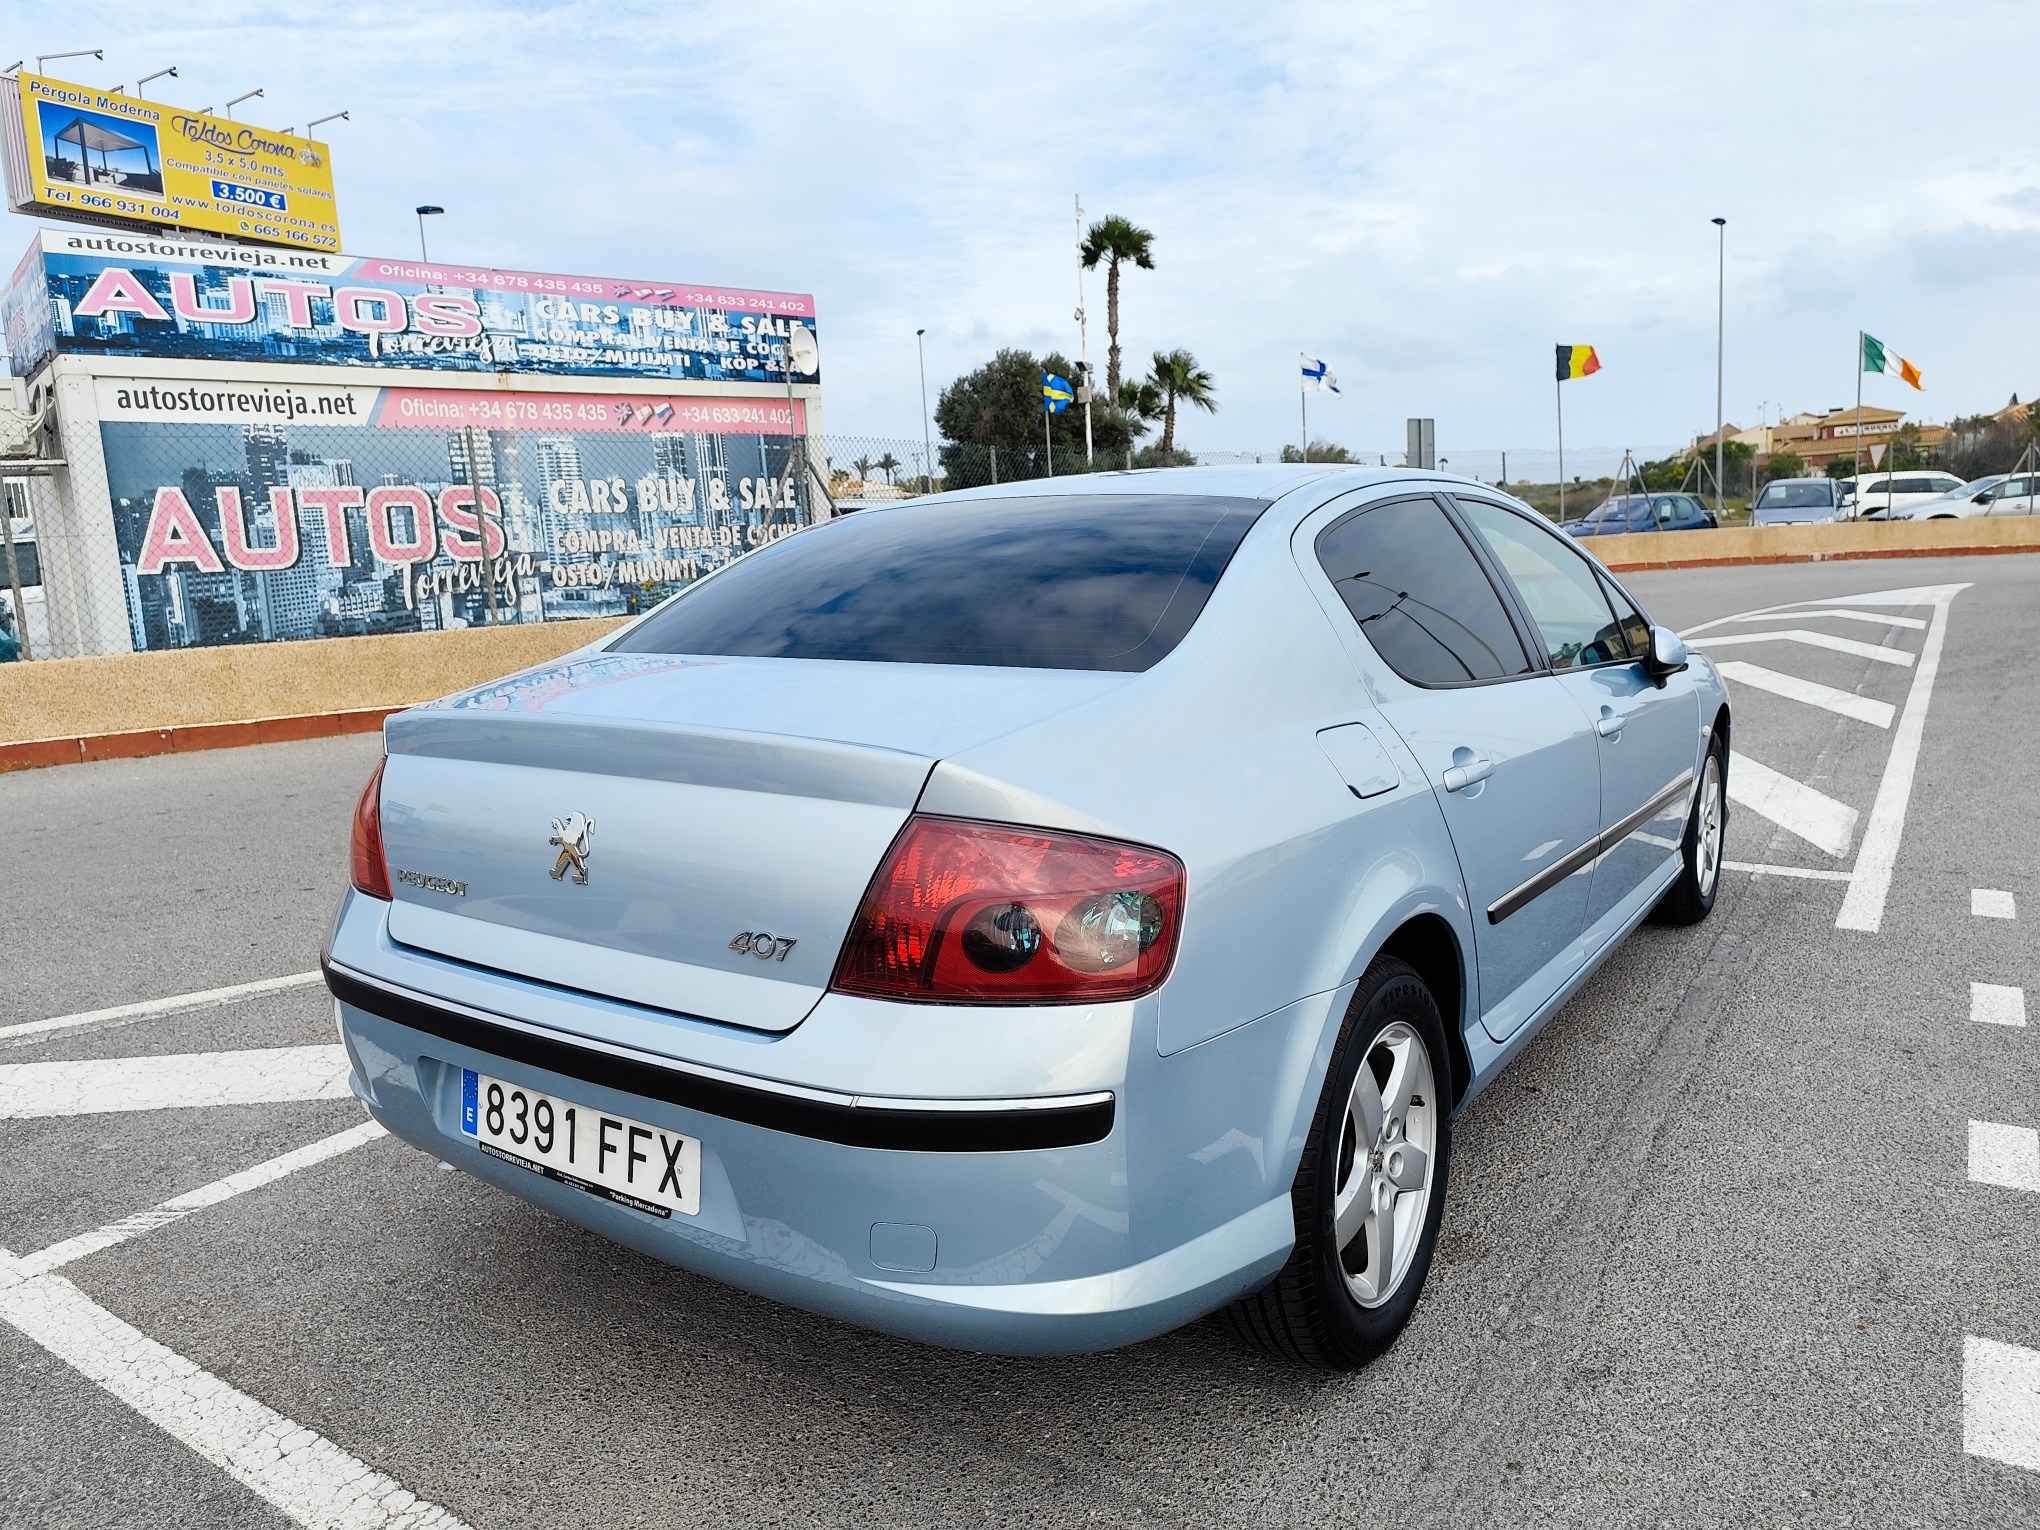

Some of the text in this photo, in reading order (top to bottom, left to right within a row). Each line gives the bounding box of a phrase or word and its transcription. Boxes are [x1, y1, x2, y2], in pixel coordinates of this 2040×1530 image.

[29, 80, 161, 121] Pérgola Moderna
[171, 114, 297, 160] Toldos Corona
[166, 157, 333, 200] Compatible con paneles solares
[204, 150, 288, 178] 3,5 x 5,0 mts.
[43, 186, 180, 220] Tel. 966 931 004
[218, 183, 281, 209] 3.500 €
[172, 195, 336, 234] www.toldoscorona.es
[254, 223, 337, 248] 665 166 572
[67, 236, 330, 270] autostorrevieja.net
[72, 267, 483, 338] AUTOS
[379, 264, 805, 312] Oficina: +34 678 435 435 +34 633 241 402
[535, 300, 619, 325] CARS
[633, 306, 696, 332] BUY
[709, 313, 731, 333] &
[368, 330, 517, 365] Torrevieja
[719, 341, 741, 353] DE
[720, 354, 759, 370] KÖP
[117, 387, 357, 420] autostorrevieja.net
[400, 397, 795, 425] Oficina: +34 678 435 435 +34 633 241 402
[550, 477, 795, 514] CARS BUY & SALE
[137, 485, 503, 576] AUTOS
[657, 526, 714, 550] VENTA
[720, 525, 741, 546] DE
[393, 555, 536, 610] Torreveja
[396, 867, 468, 897] PEUGEOT
[728, 930, 798, 963] 407
[465, 1106, 474, 1123] E
[486, 1083, 684, 1200] 8391 FFX
[481, 1144, 544, 1175] AUTOSTORREVIEJA.NET
